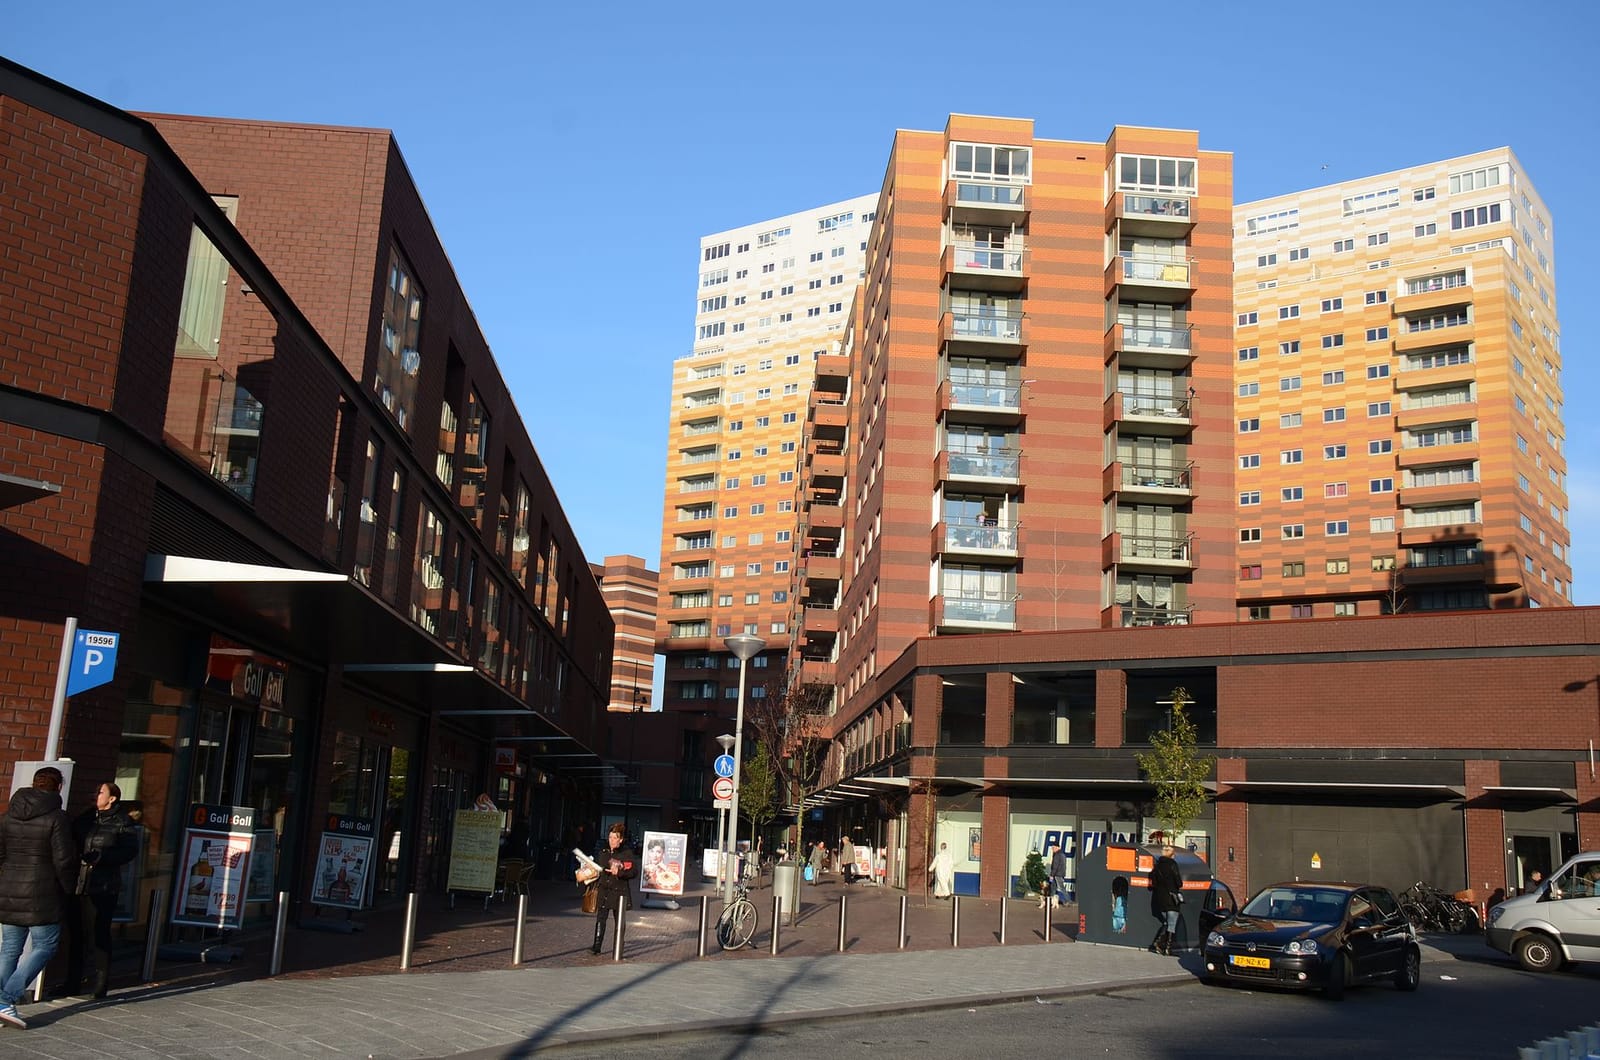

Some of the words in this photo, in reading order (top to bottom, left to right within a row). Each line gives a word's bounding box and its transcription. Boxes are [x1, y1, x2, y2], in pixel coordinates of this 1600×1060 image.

[88, 636, 113, 645] 19596
[83, 650, 104, 675] P
[244, 663, 264, 697] Gall
[266, 671, 284, 704] Gall
[210, 812, 229, 824] Gall
[233, 814, 252, 827] Gall
[339, 820, 354, 830] Gall
[356, 822, 371, 832] Gall
